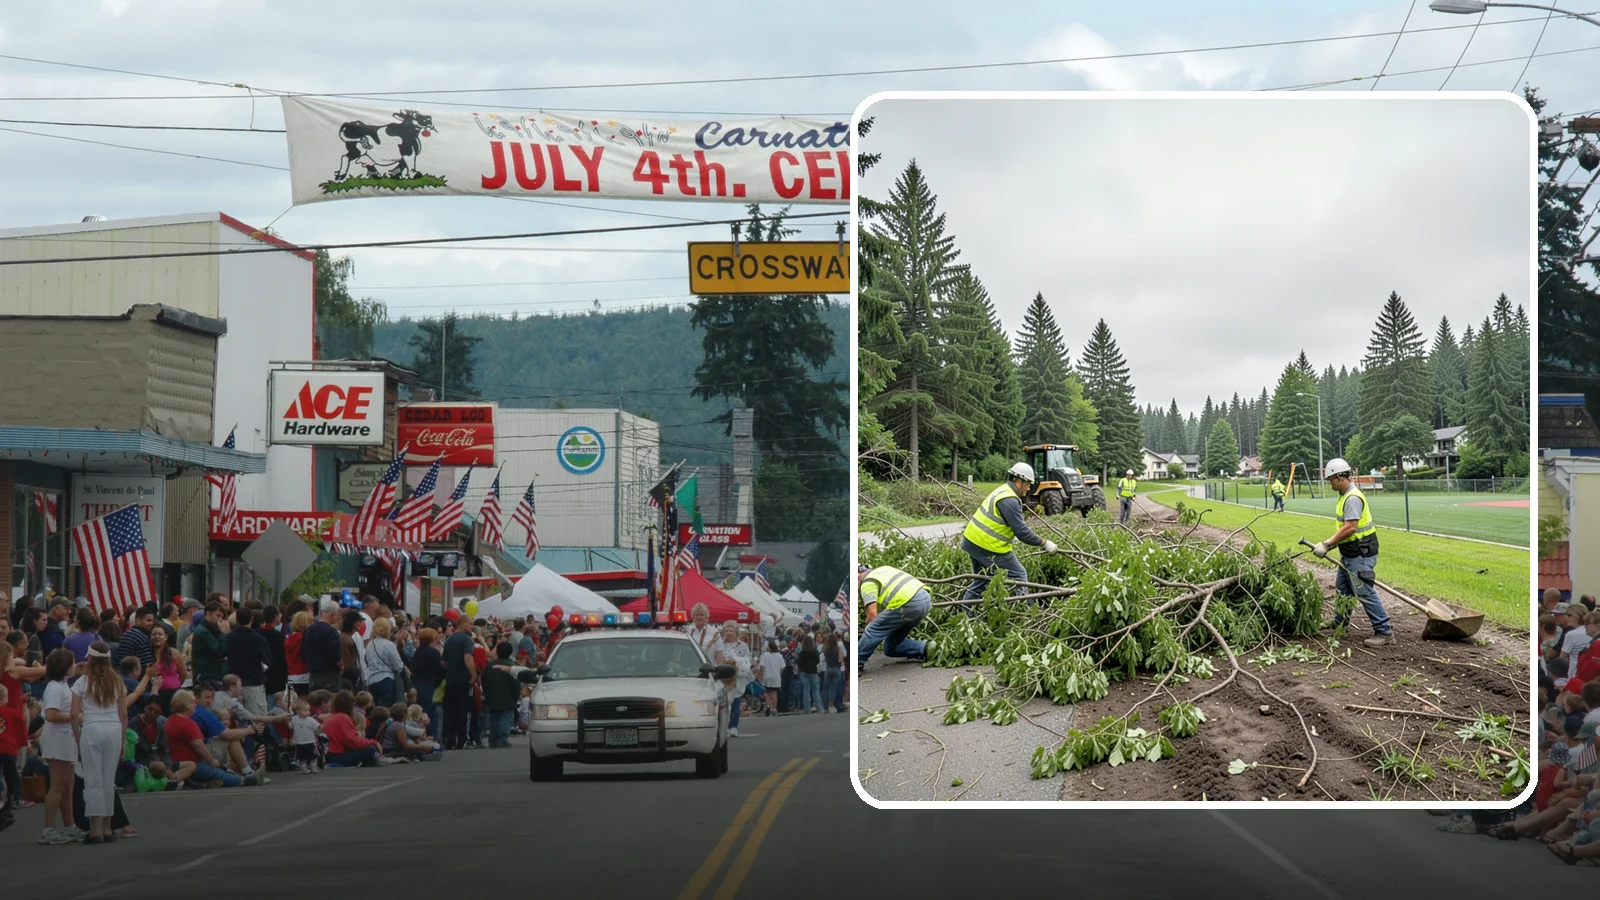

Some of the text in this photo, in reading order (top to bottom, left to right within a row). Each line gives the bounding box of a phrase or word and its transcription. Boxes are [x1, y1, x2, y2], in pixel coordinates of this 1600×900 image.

[695, 121, 850, 150] Carnat
[480, 141, 605, 192] JULY
[631, 149, 746, 198] 4th.
[697, 254, 850, 280] CROSSWA
[282, 379, 374, 421] ACE
[405, 409, 453, 422] CEDAR
[283, 420, 371, 437] Hardware
[416, 428, 477, 447] Coca-Cola
[353, 467, 386, 480] Simpl
[83, 484, 155, 495] St. Vincent de Paul
[688, 526, 741, 535] CRNATION
[699, 535, 730, 544] GLASS
